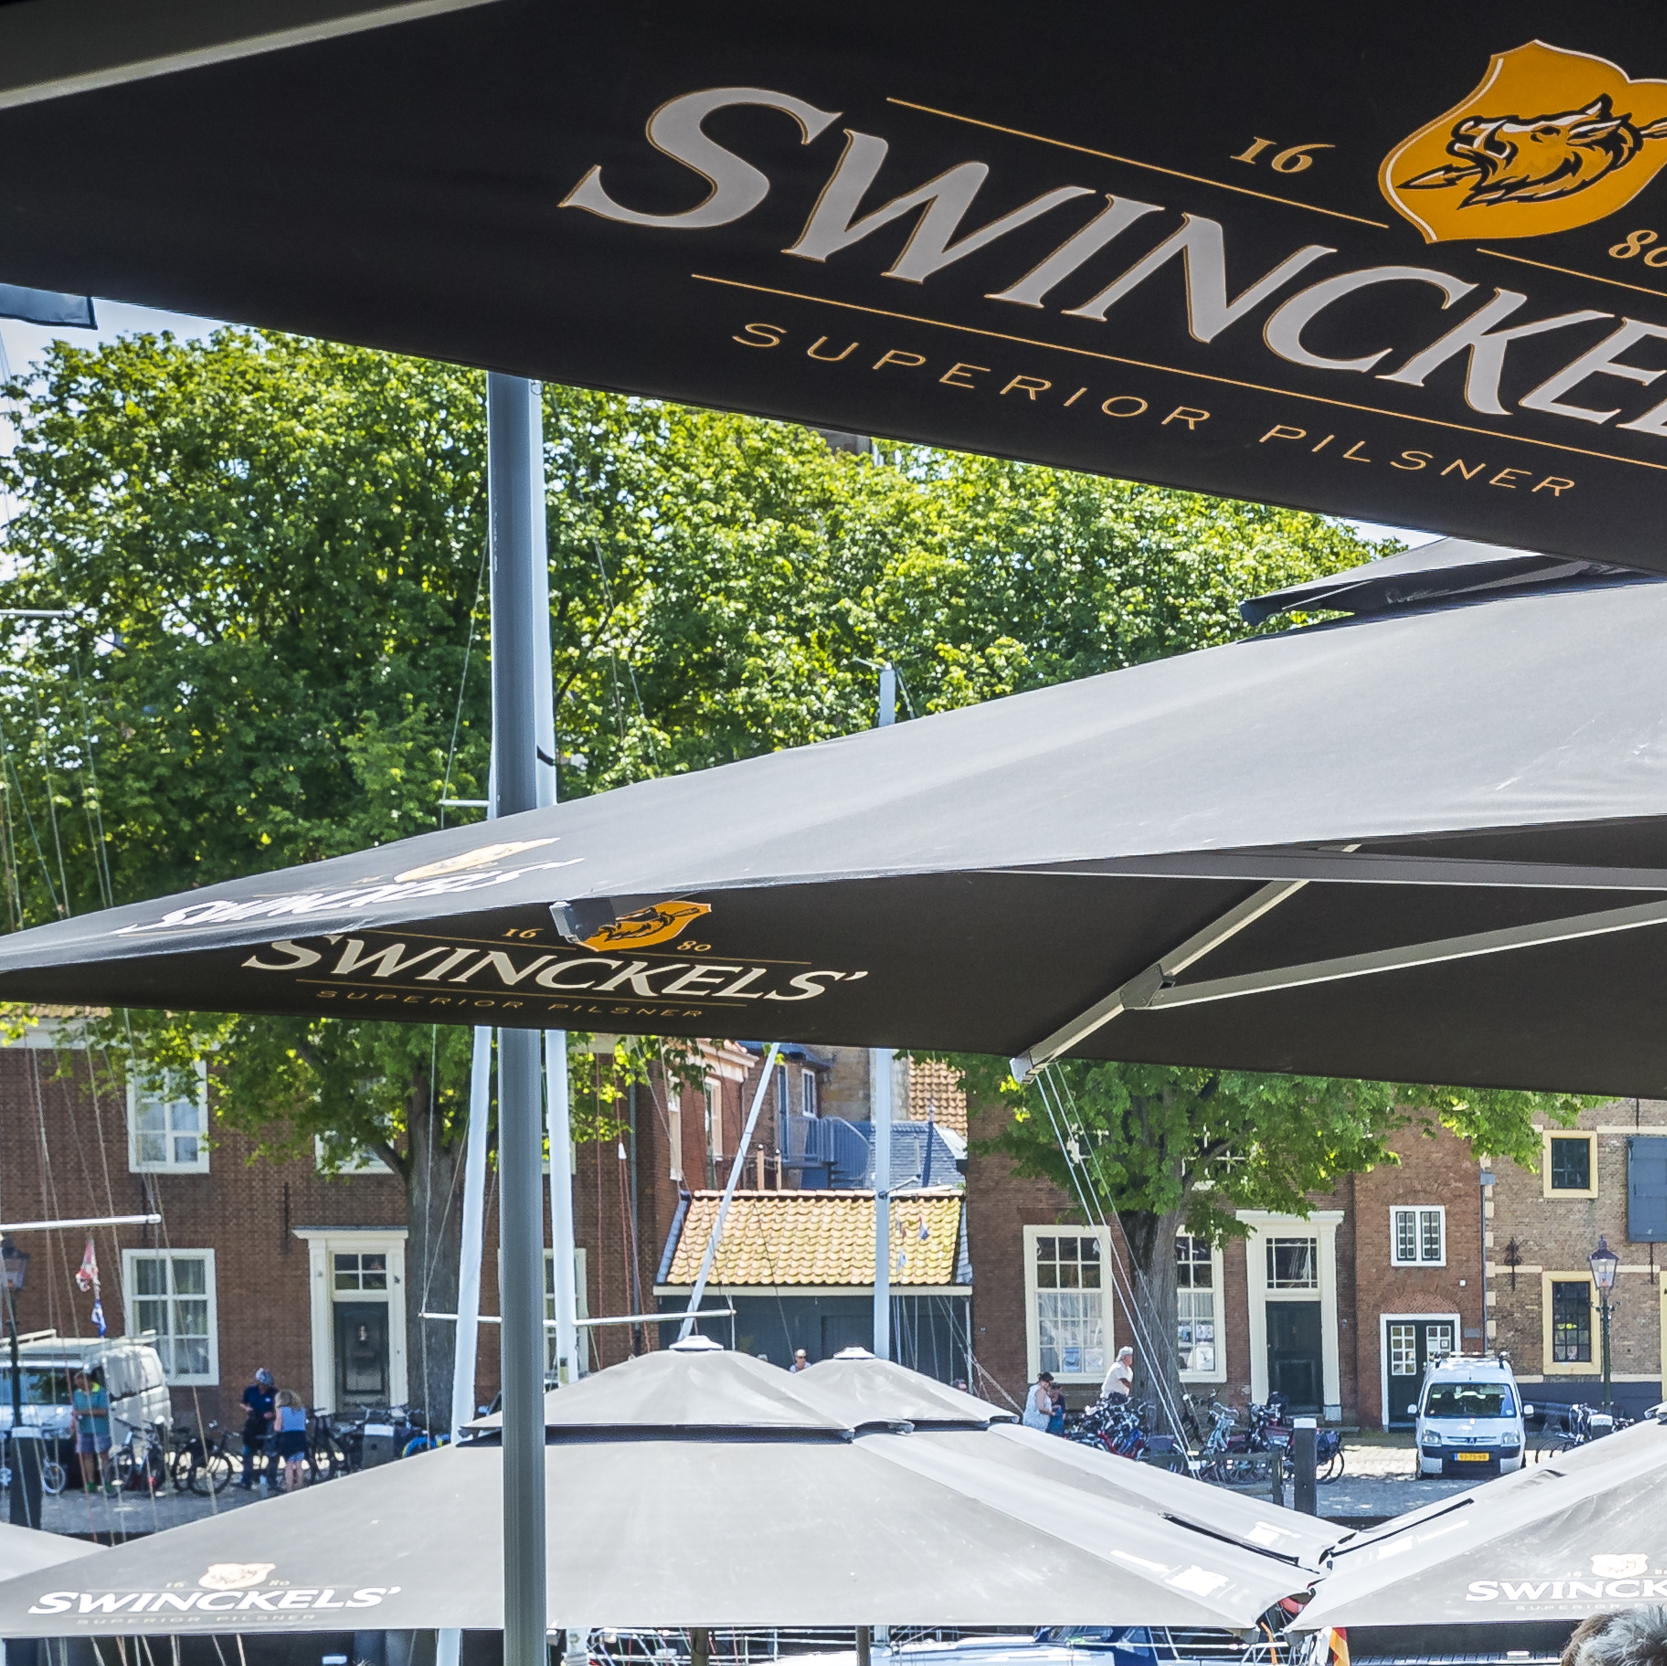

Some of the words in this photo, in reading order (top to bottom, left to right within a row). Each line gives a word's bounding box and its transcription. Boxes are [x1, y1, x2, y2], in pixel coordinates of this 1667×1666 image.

[1227, 135, 1336, 175] 16
[731, 322, 1212, 431] SUPERIOR
[1258, 424, 1576, 498] PILSNER
[502, 927, 538, 940] 16
[676, 940, 711, 952] 80
[315, 989, 524, 1009] SUPERIOR
[547, 1003, 704, 1018] PILSNER
[76, 1616, 201, 1625] SUPERIOR
[216, 1613, 316, 1623] PILSNER
